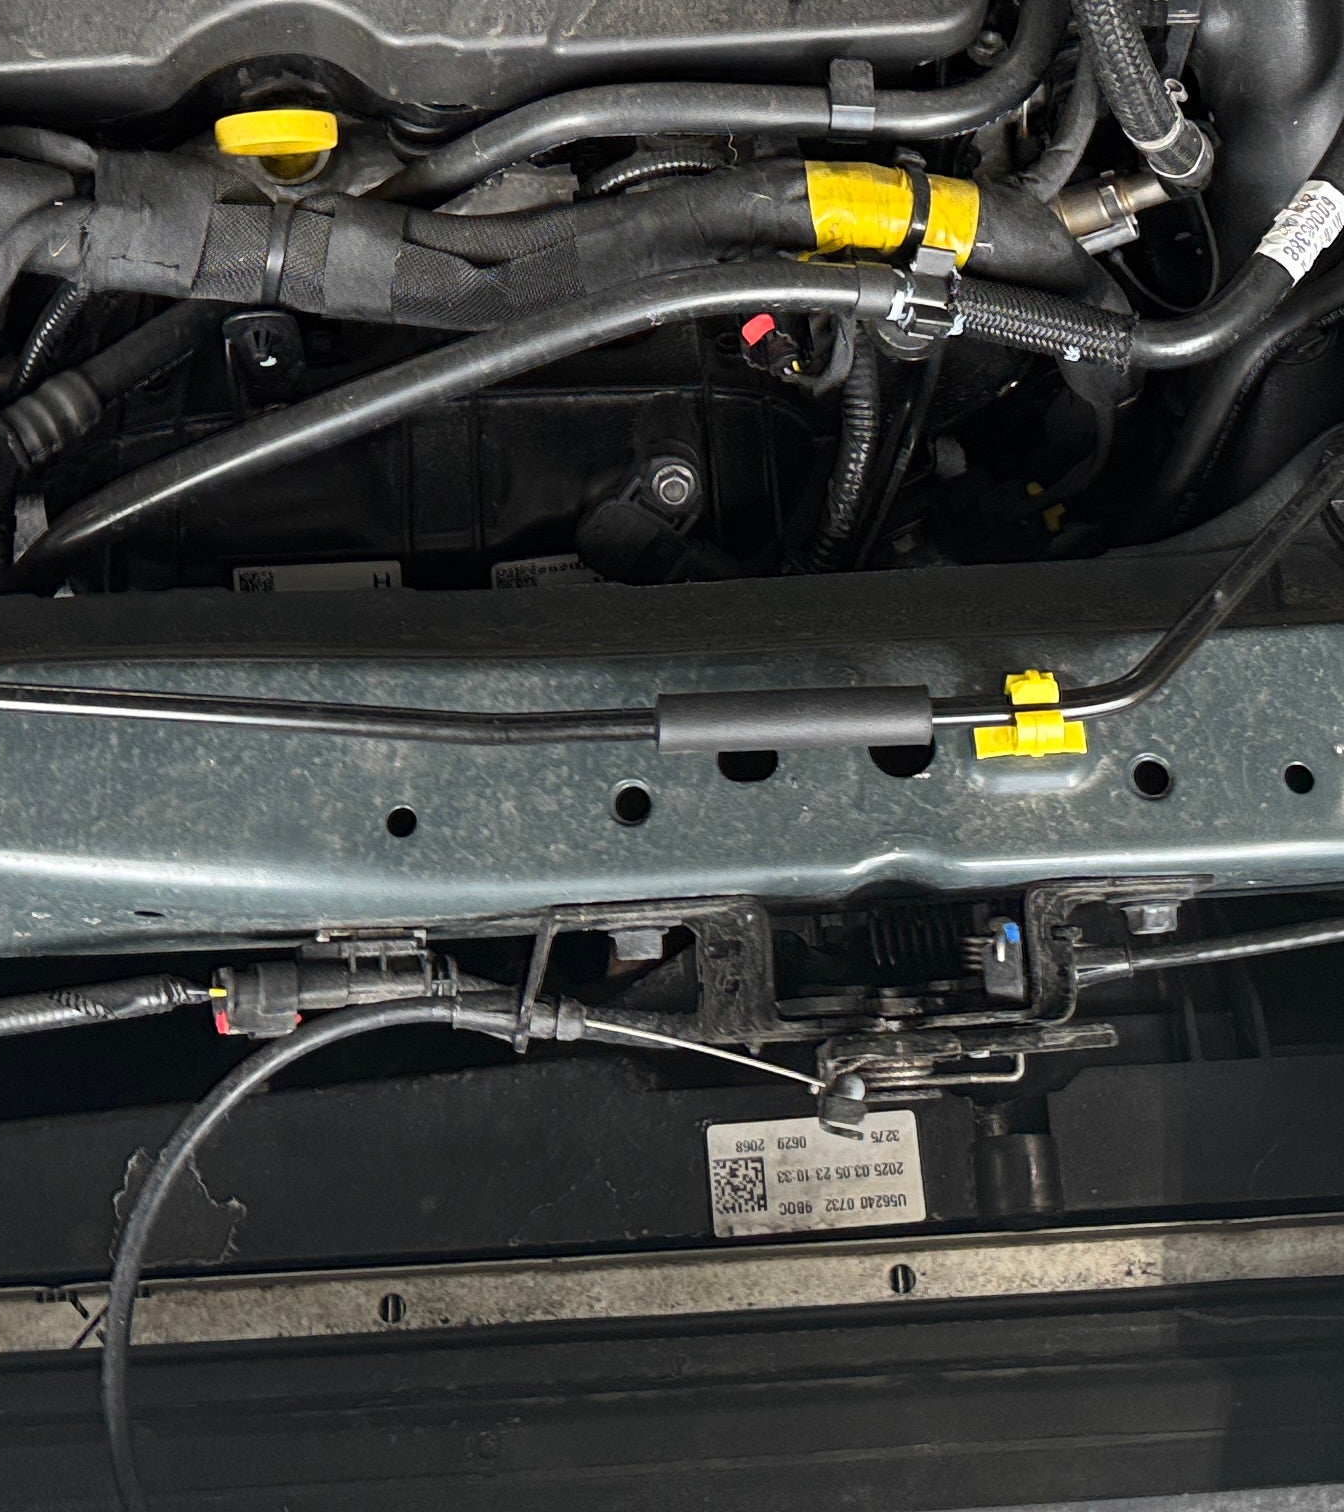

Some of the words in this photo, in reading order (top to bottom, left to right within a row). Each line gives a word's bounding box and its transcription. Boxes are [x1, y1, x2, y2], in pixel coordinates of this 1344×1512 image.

[777, 1136, 807, 1150] 0629
[870, 1129, 900, 1144] 3275
[735, 1138, 765, 1153] 2068
[825, 1197, 855, 1212] 0732
[861, 1194, 907, 1210] U56240
